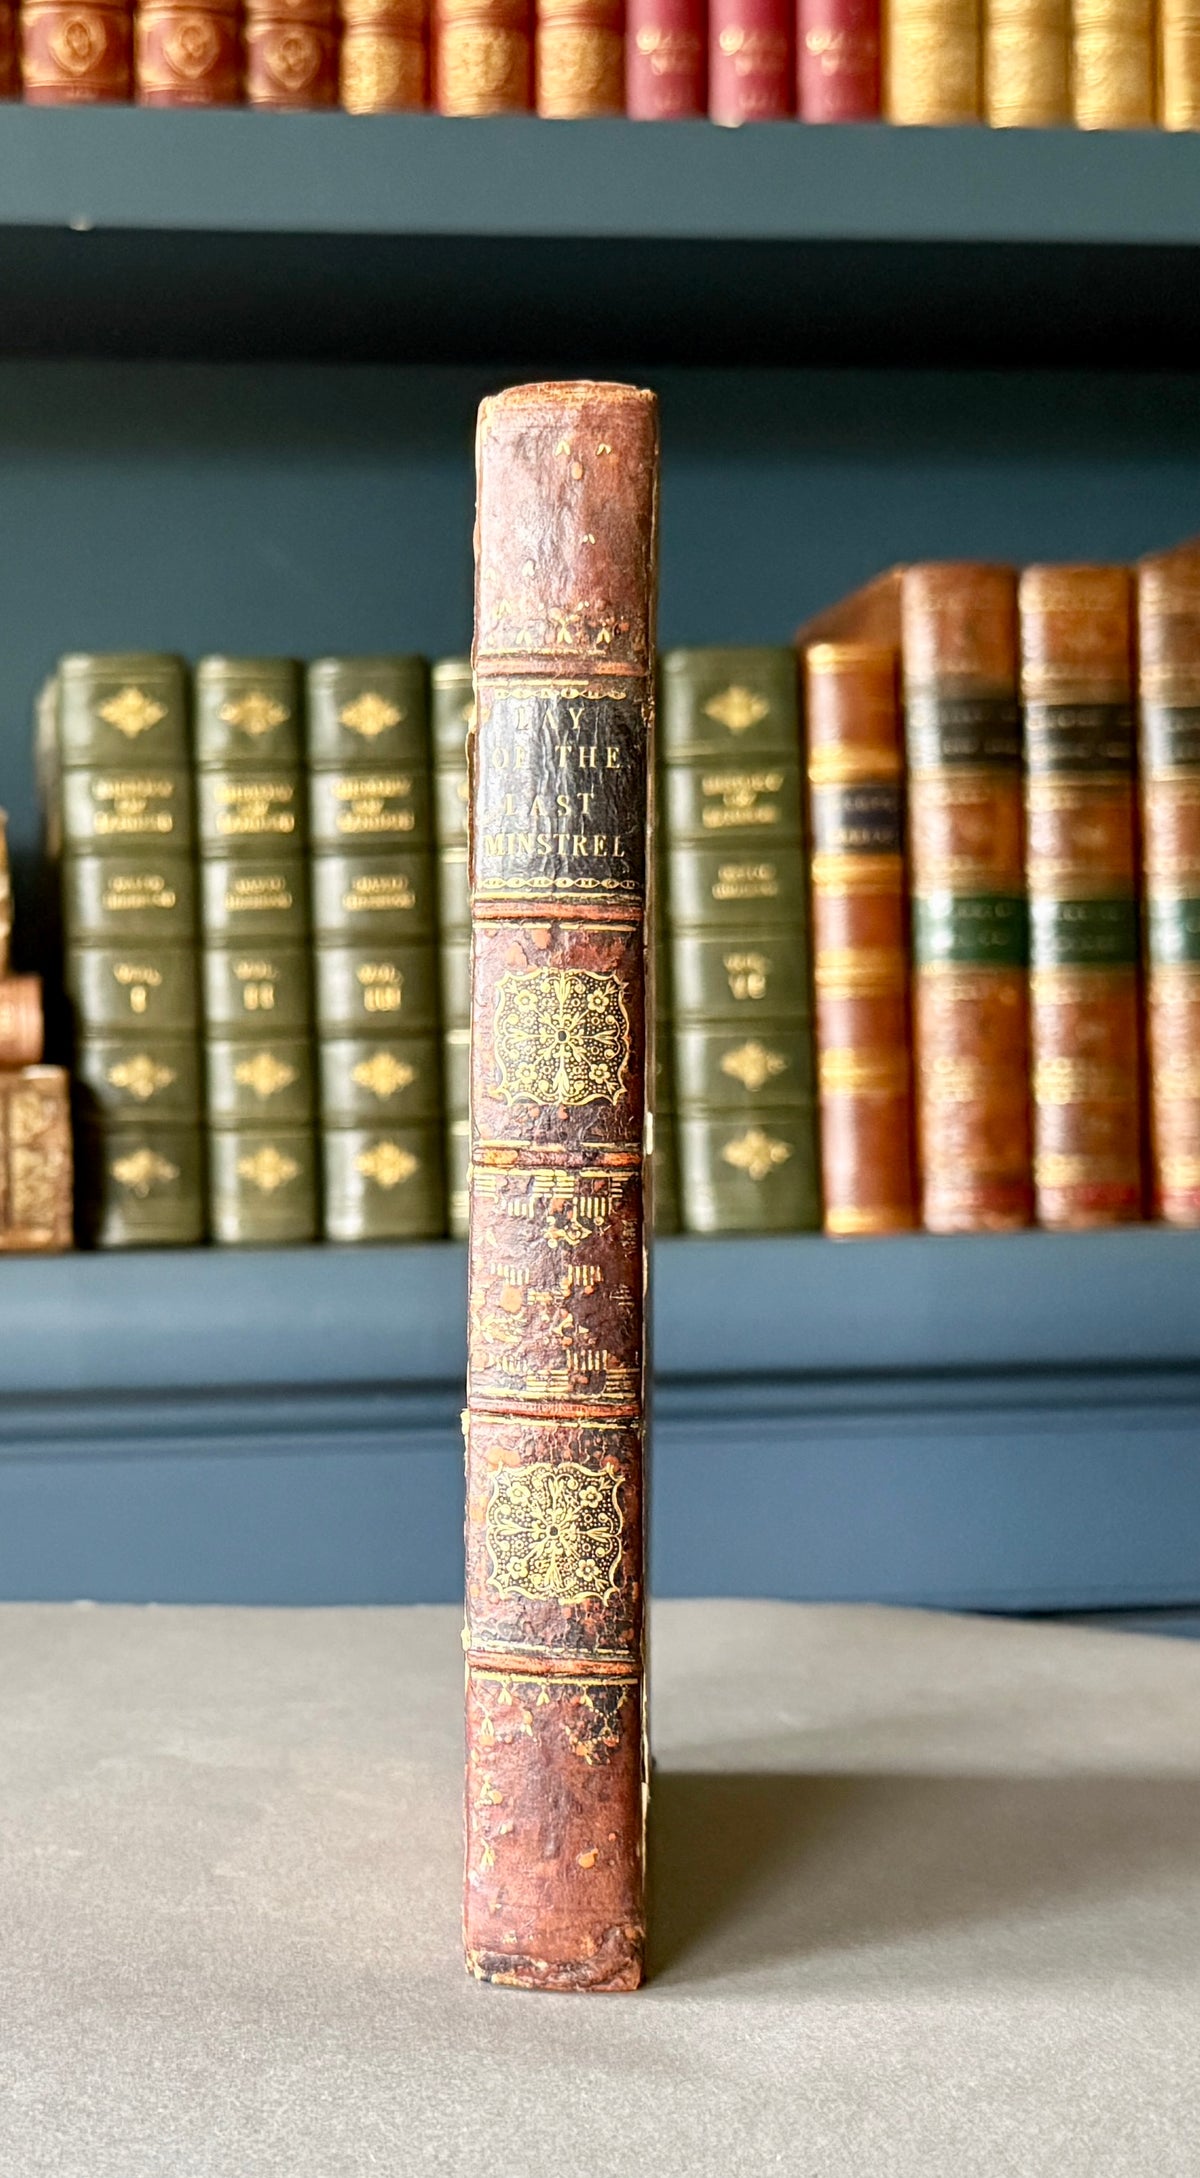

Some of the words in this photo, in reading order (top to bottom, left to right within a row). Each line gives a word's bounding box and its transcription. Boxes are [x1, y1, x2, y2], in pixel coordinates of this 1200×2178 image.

[515, 706, 585, 730] LAY
[493, 746, 528, 771] OF
[555, 745, 621, 769] THE
[504, 793, 595, 816] LAST
[484, 834, 625, 858] MINSTREL
